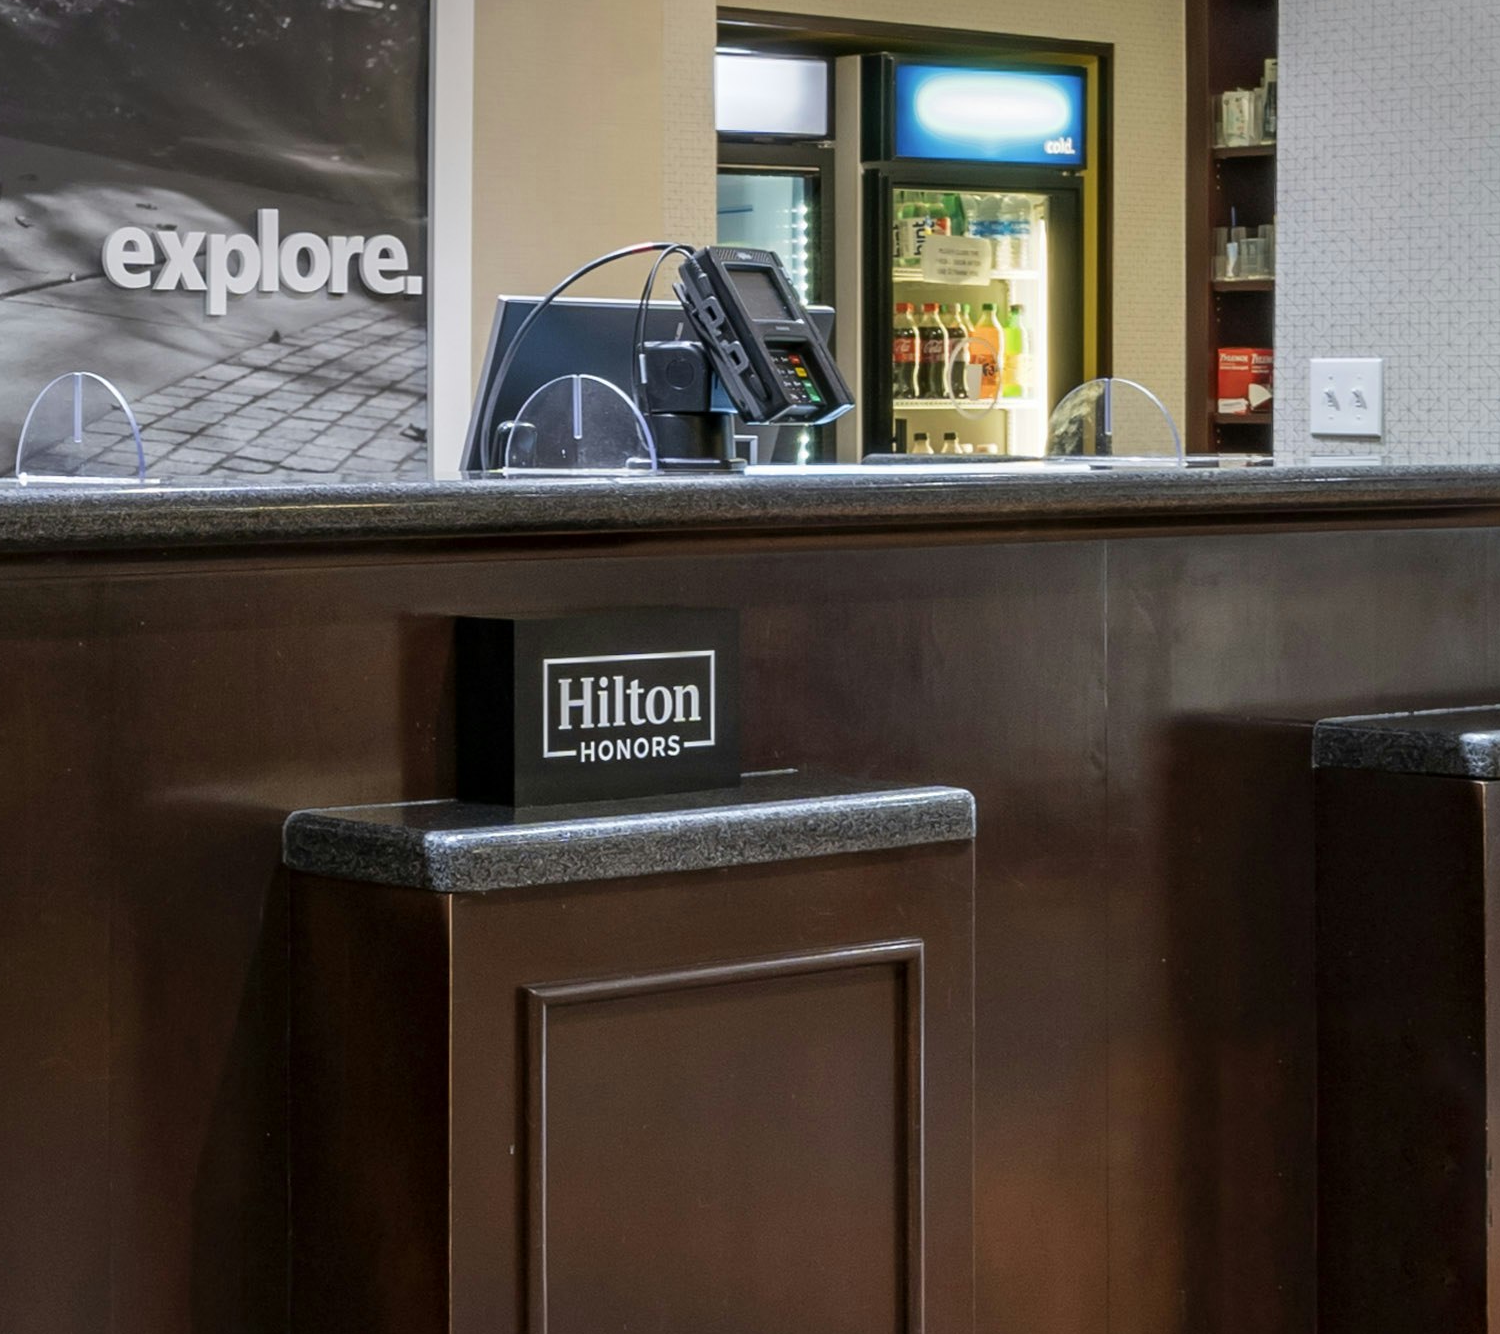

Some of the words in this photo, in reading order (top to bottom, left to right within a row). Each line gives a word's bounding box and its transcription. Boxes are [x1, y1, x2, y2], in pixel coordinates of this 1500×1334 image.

[1043, 136, 1076, 155] cold.
[102, 208, 423, 316] explore.
[558, 675, 702, 730] Hilton
[580, 734, 681, 763] HONORS
